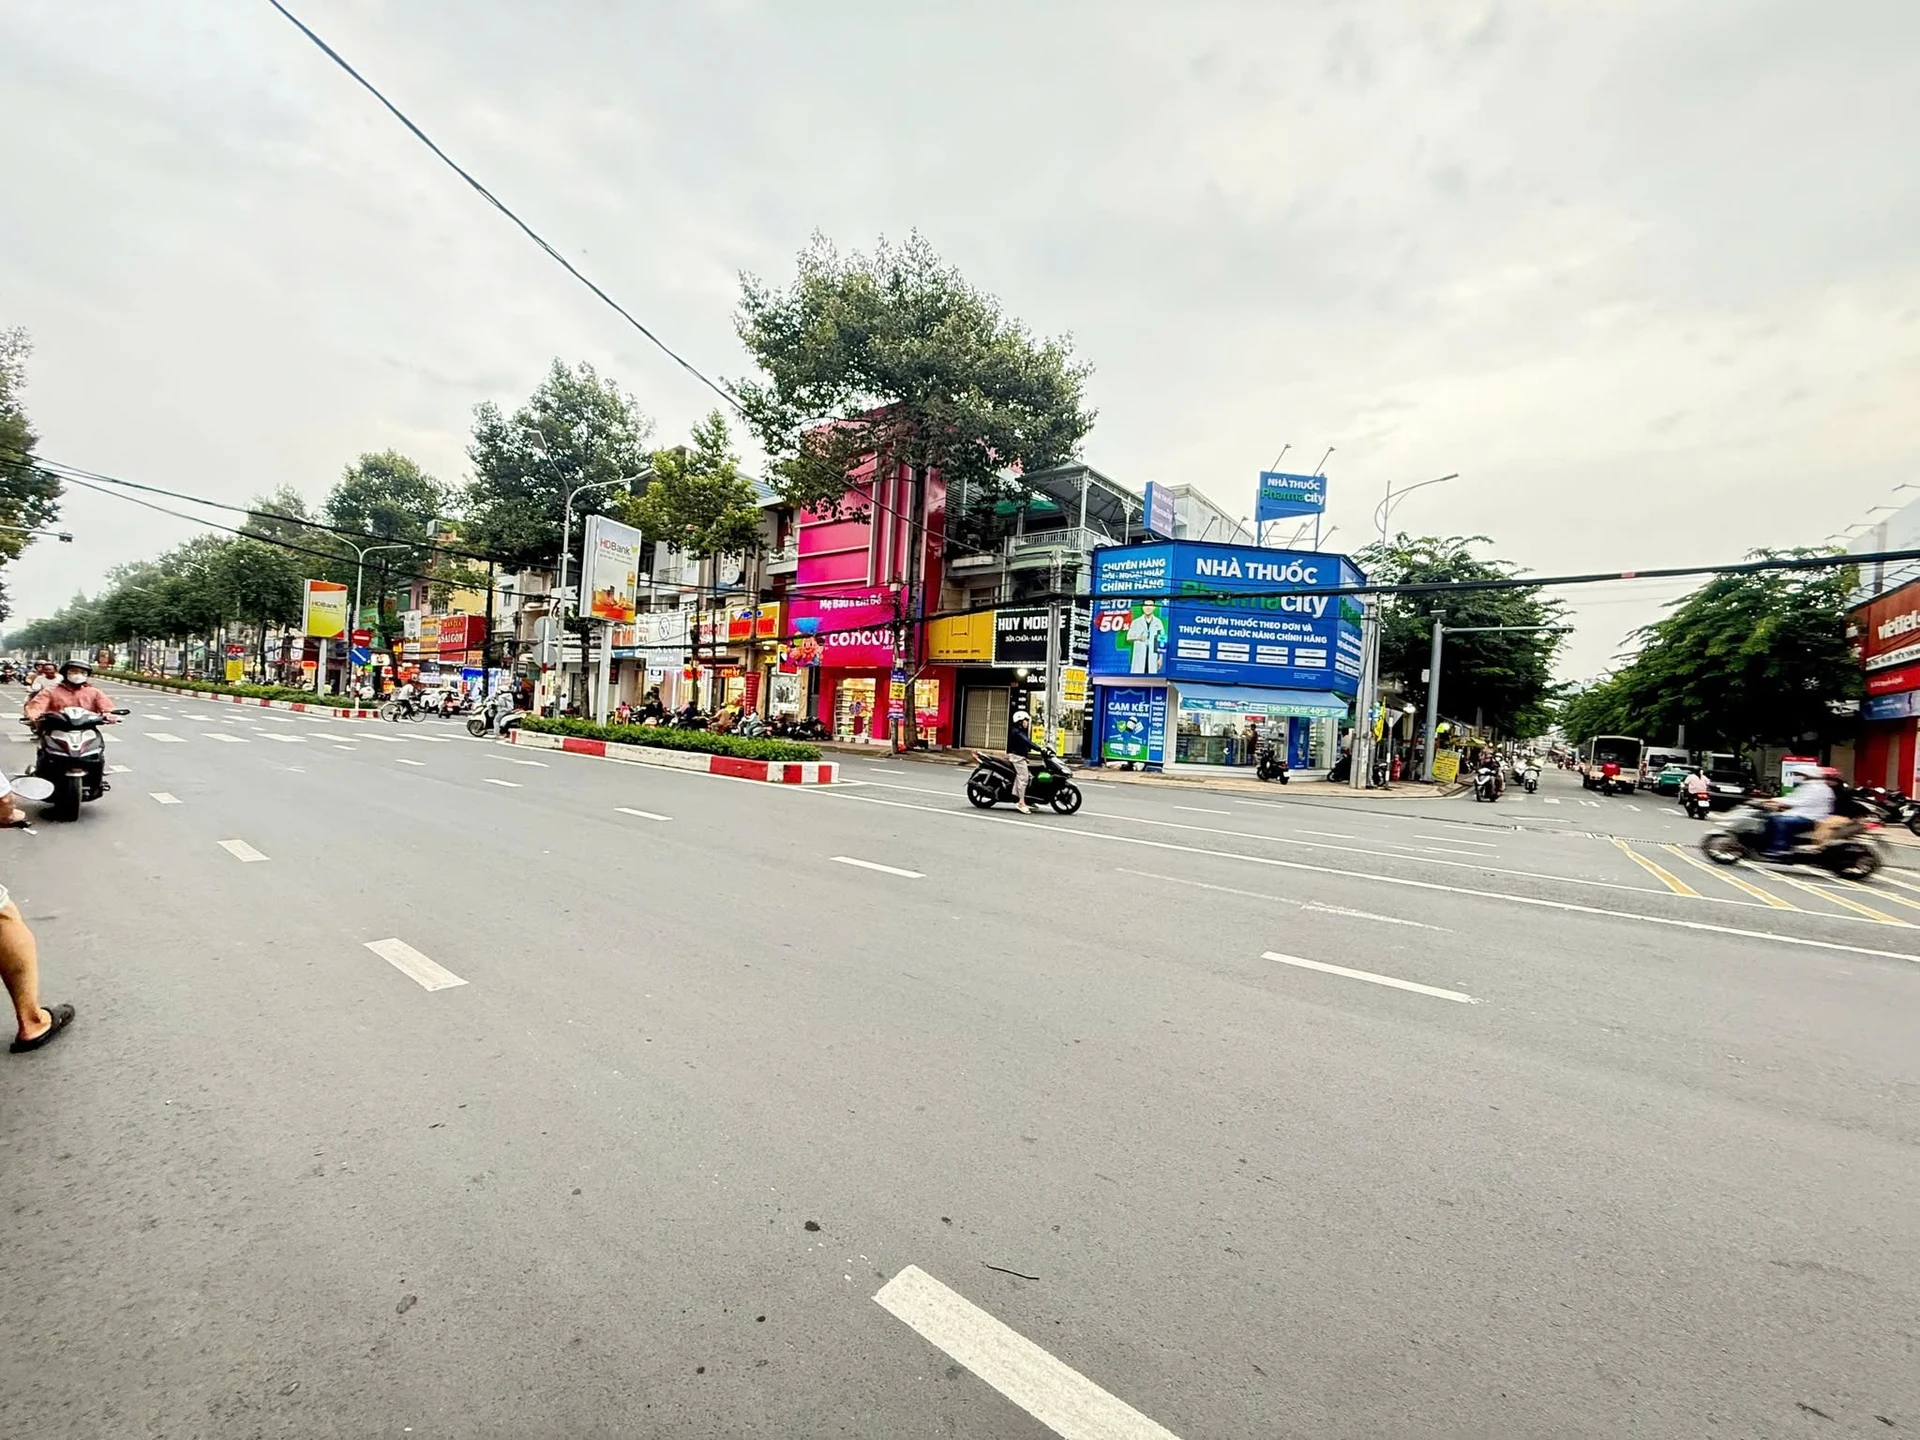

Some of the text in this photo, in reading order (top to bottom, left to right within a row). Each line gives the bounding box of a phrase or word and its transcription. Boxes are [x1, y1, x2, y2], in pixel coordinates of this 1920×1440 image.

[1267, 477, 1321, 490] NHÀ THUỐC
[1261, 488, 1325, 506] Pharmacity
[600, 538, 630, 555] HDBank
[1102, 557, 1166, 572] CHUYÊN HÀNG
[1196, 557, 1318, 585] NHÀ THUỐC
[1100, 580, 1133, 592] CHÍNH
[997, 615, 1067, 631] HUY MOBE
[1195, 615, 1313, 632] CHUYÊN THUỐC THEO ĐƠN VÀ
[1178, 625, 1202, 636] THỰC
[1203, 626, 1228, 637] PHẨM
[1229, 627, 1251, 638] CHỨC
[1251, 629, 1276, 640] NĂNG
[1276, 631, 1302, 642] CHÍNH
[1303, 633, 1328, 644] HÃNG
[1107, 701, 1150, 712] CAM KẾT
